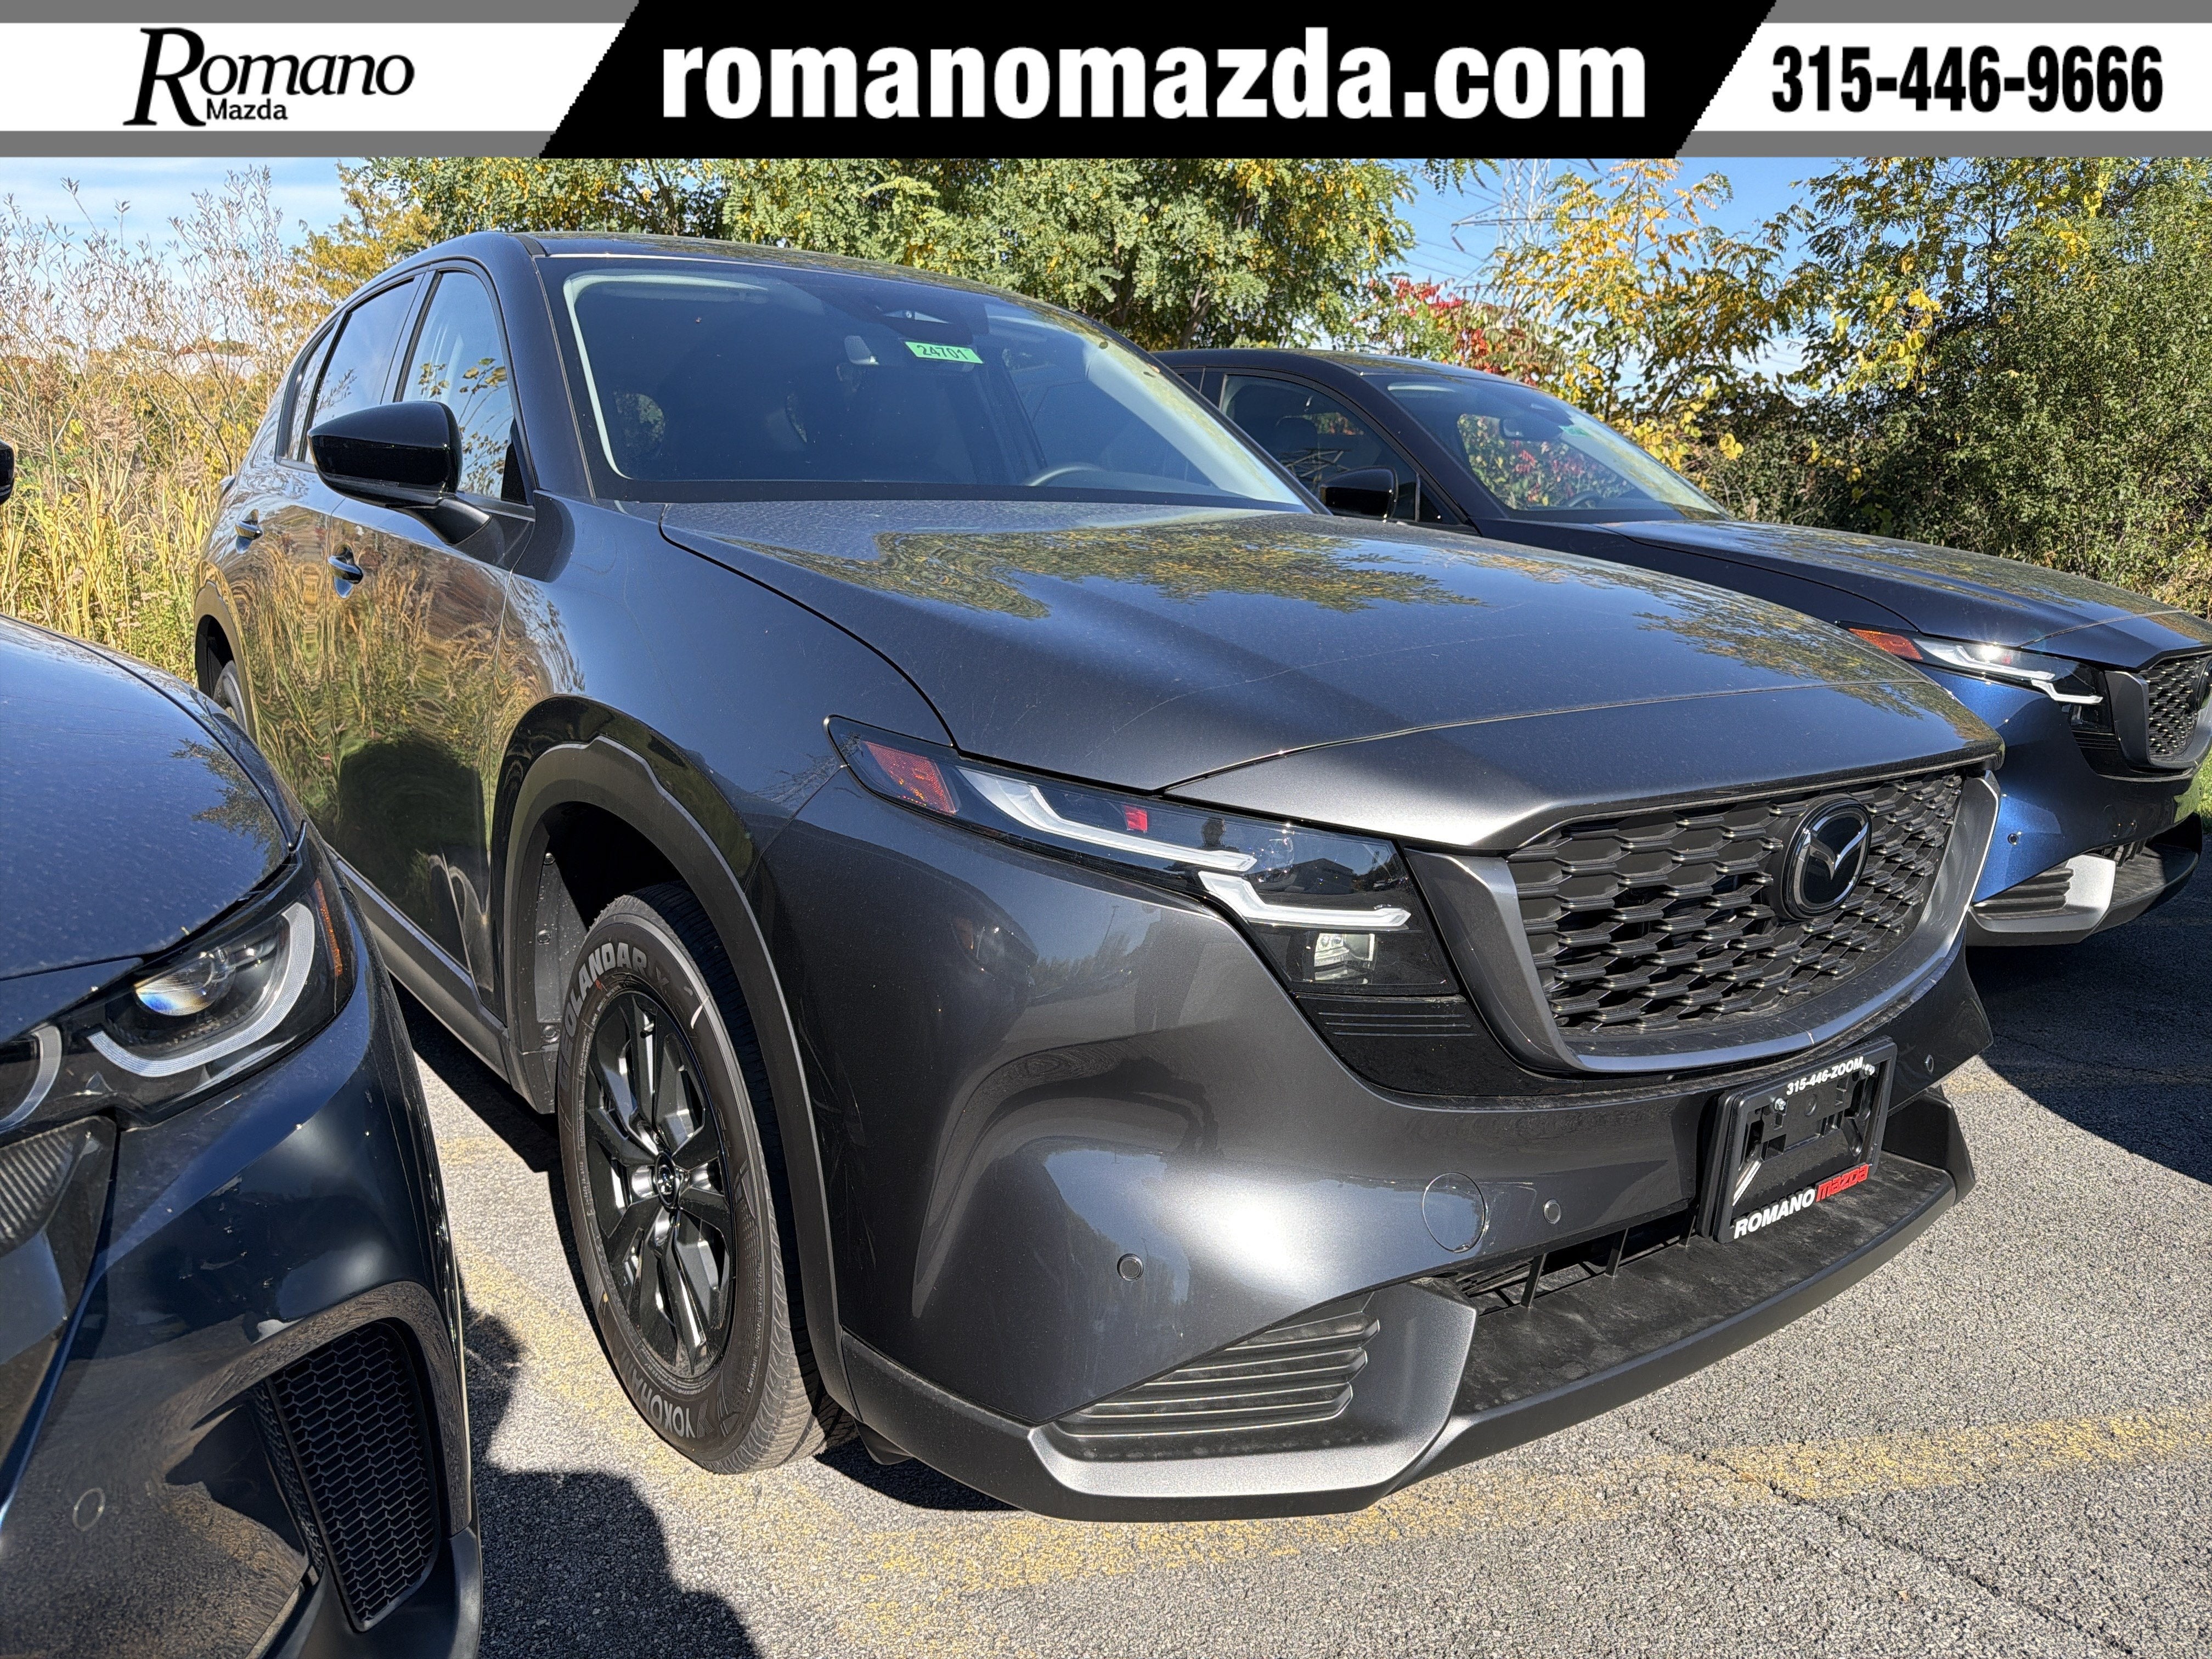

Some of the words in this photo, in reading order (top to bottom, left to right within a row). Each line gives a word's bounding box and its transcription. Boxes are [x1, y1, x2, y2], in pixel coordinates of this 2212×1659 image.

[917, 345, 968, 360] 24701
[1786, 1056, 1863, 1096] 315-446-ZOOM
[1734, 1188, 1815, 1239] ROMANO
